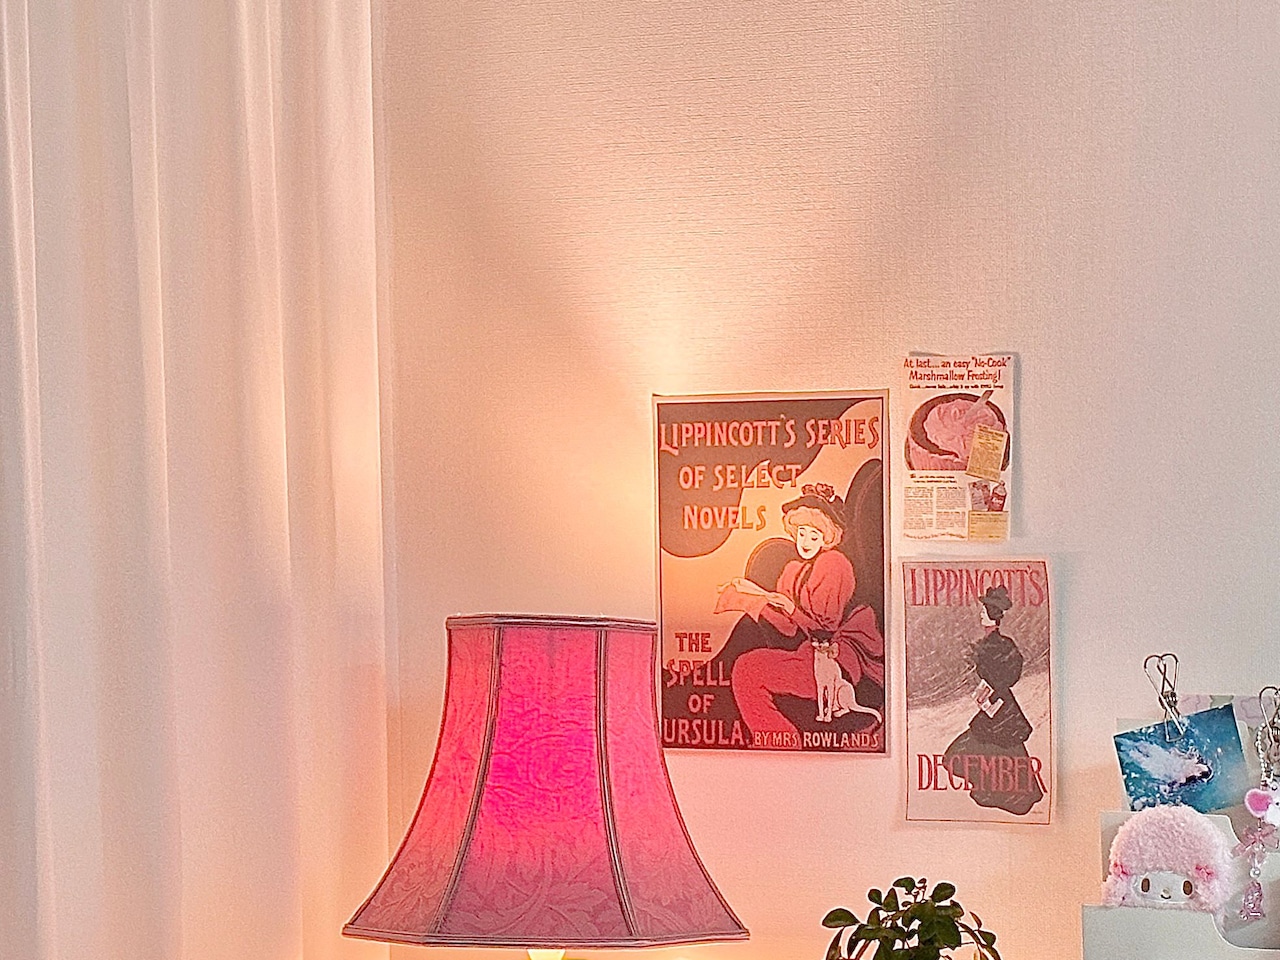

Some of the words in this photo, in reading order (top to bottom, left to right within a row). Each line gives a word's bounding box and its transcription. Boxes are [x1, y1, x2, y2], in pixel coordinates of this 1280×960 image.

[904, 358, 913, 368] At
[953, 361, 971, 370] easy
[909, 370, 965, 381] Marshmallow
[967, 369, 1001, 384] Frosting!
[659, 415, 797, 456] LIPPINCOTT'S
[805, 416, 880, 450] SERIES
[679, 465, 706, 489] OF
[712, 463, 802, 491] SELECT
[683, 504, 767, 531] NOVELS
[910, 565, 1045, 607] LIPPINCOTT'S
[675, 632, 712, 653] THE
[667, 659, 731, 687] SPELL
[688, 694, 714, 713] OF
[753, 731, 771, 747] BY
[803, 731, 879, 749] ROWLANDS
[916, 754, 1048, 794] DECEMBER
